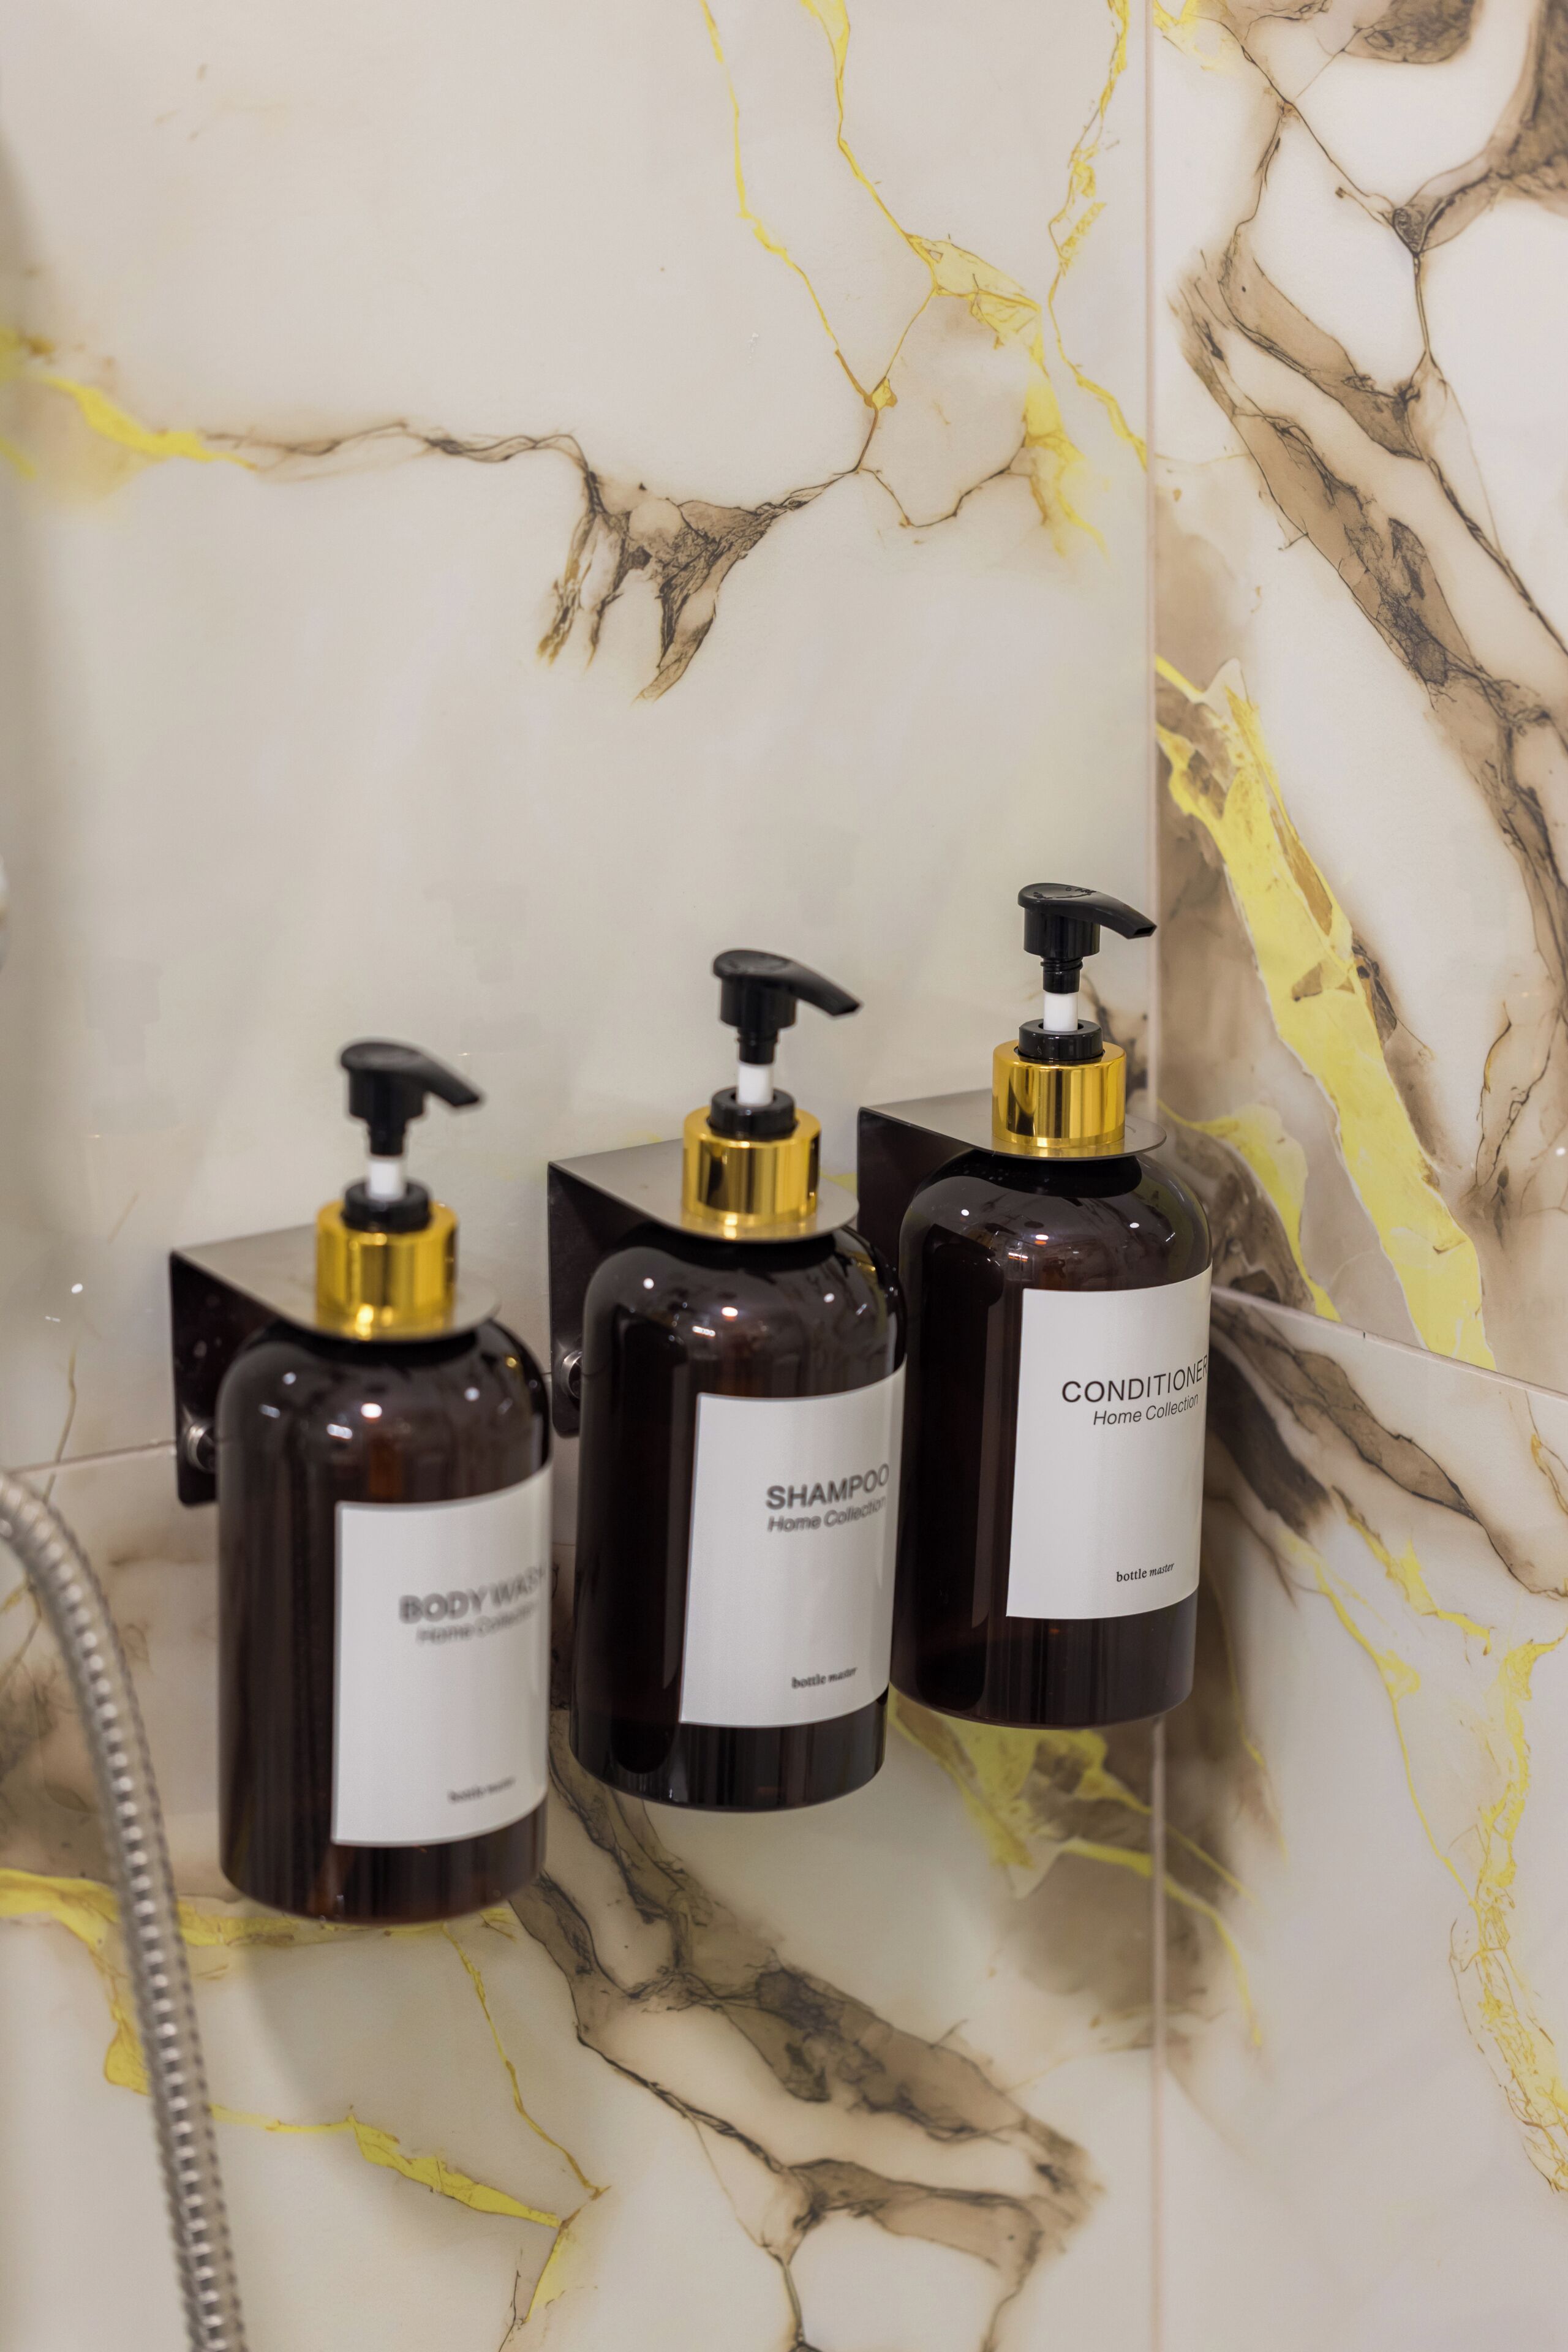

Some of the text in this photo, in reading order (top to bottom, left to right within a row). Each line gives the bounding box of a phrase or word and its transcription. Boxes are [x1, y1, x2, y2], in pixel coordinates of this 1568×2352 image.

[1062, 1354, 1207, 1403] CONDITIONER
[1093, 1393, 1199, 1425] Home Collection
[766, 1463, 889, 1510] SHAMPOO
[767, 1515, 821, 1532] Home
[1116, 1563, 1175, 1582] bottle master
[399, 1585, 489, 1624] BODY
[791, 1673, 826, 1689] bottle
